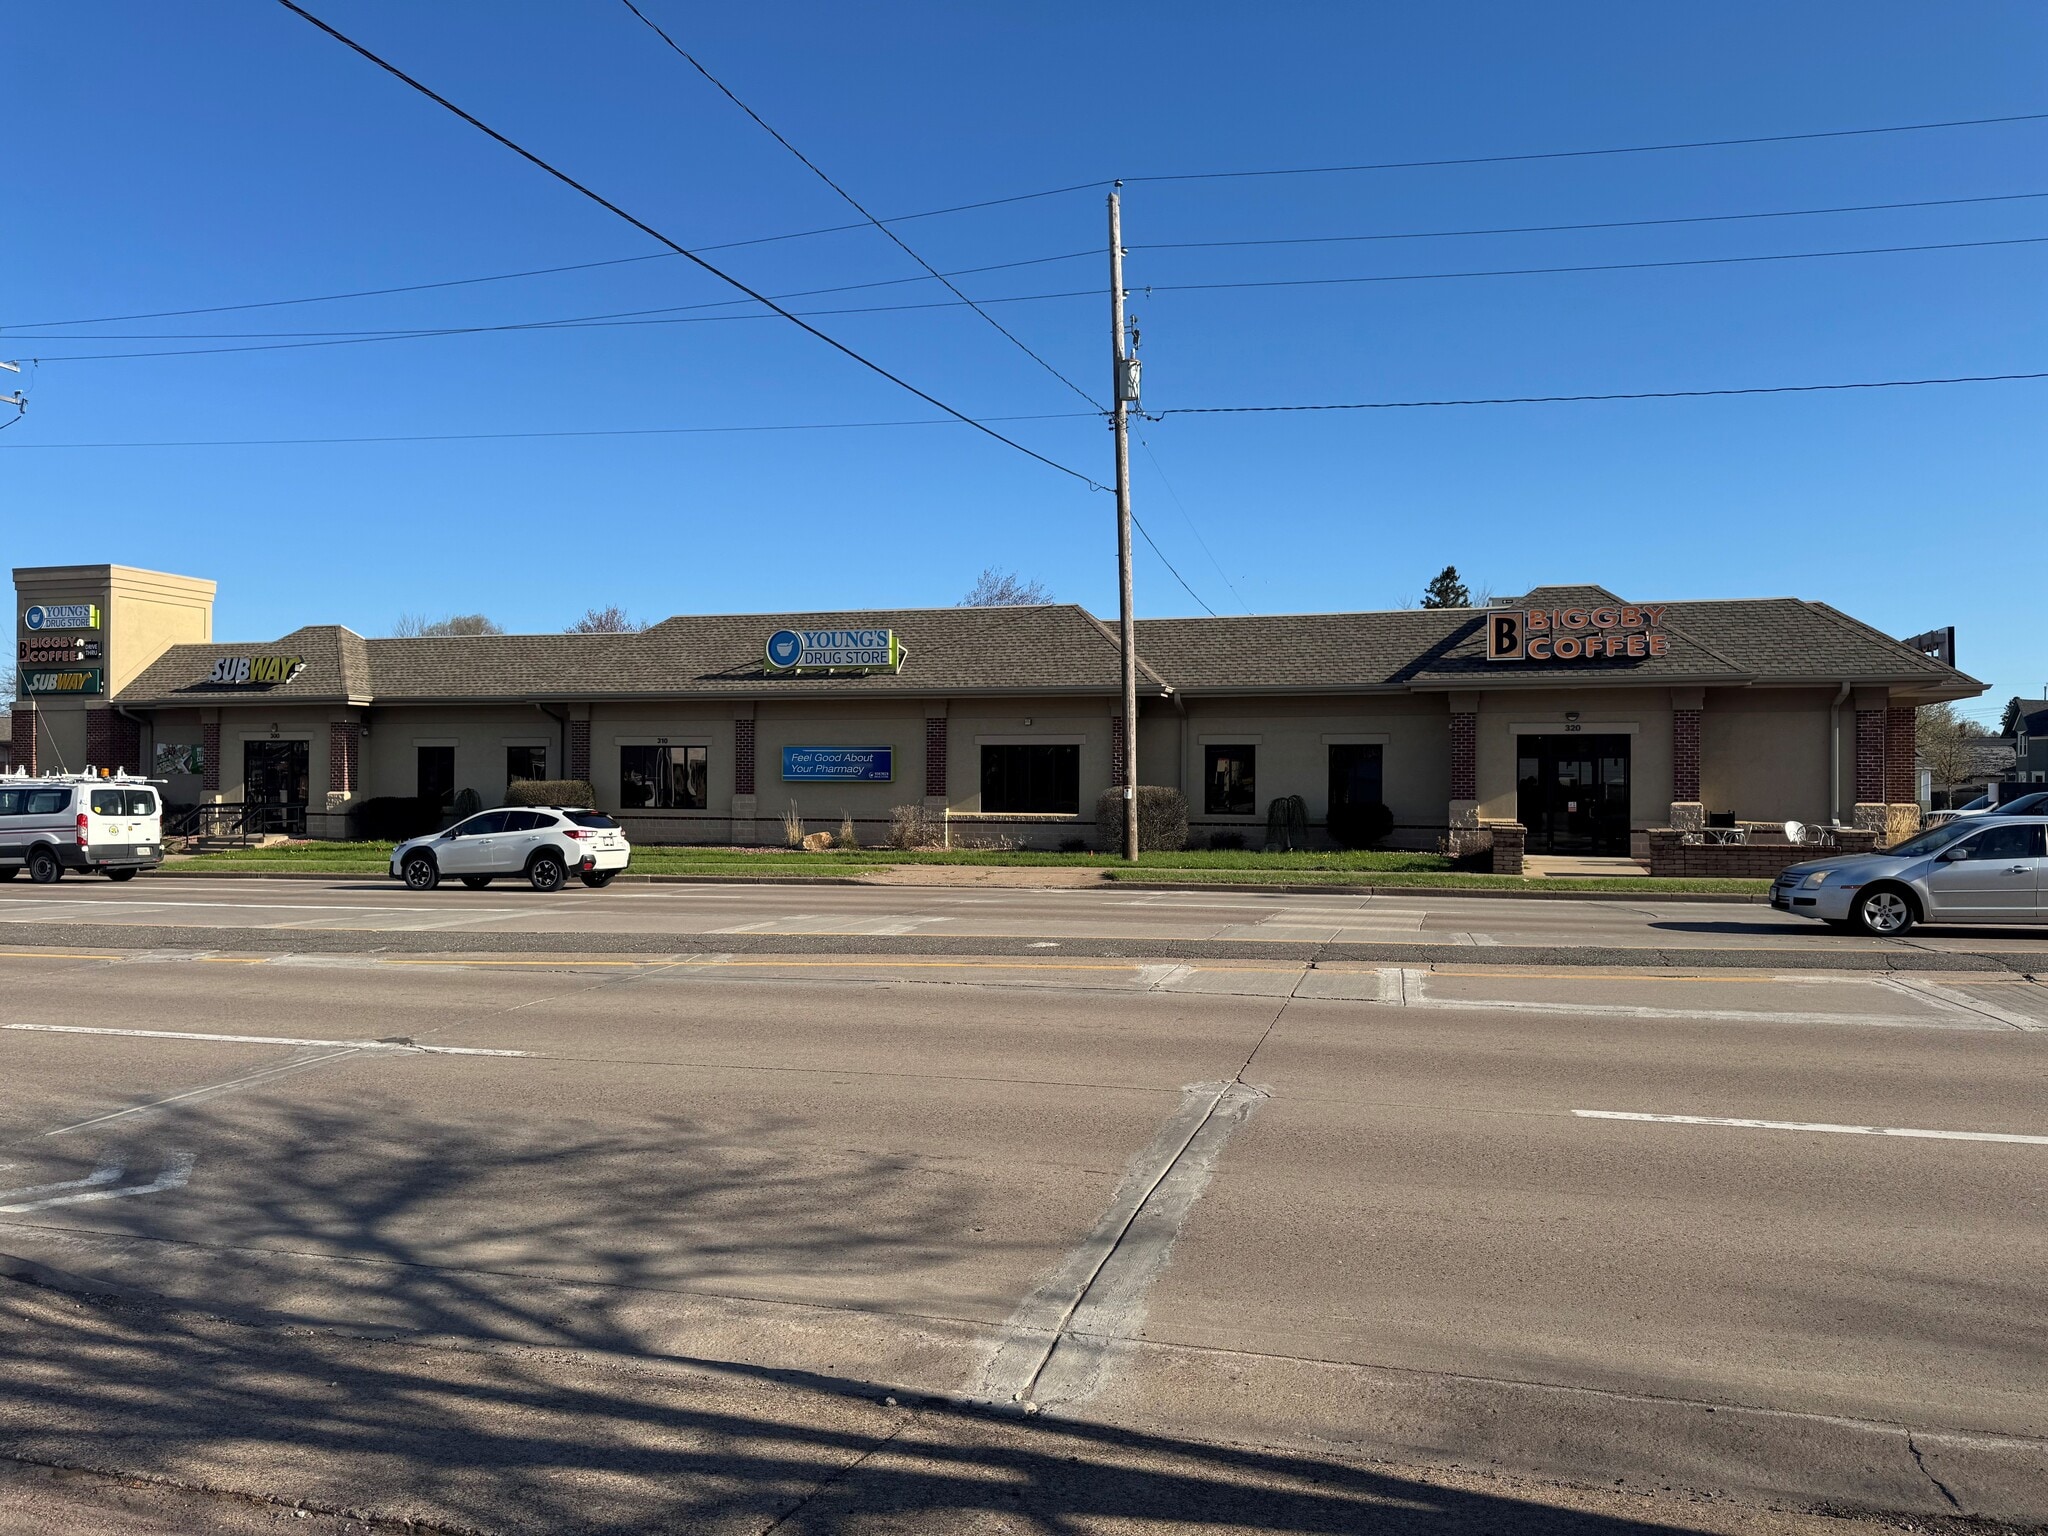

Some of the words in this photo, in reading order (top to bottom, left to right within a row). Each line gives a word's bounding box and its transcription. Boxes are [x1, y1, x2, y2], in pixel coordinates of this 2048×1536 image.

[46, 606, 90, 617] YOUNG'S
[1527, 606, 1667, 630] BIGGBY
[45, 619, 66, 628] DRUG
[67, 618, 90, 627] STORE
[31, 637, 77, 648] BIGGBY
[803, 631, 888, 648] YOUNG'S
[1495, 617, 1518, 655] B
[1527, 634, 1669, 660] COFFEE
[30, 651, 77, 662] COFFEE
[804, 651, 842, 665] DRUG
[845, 650, 888, 664] STORE
[208, 656, 302, 683] SUBWAY
[30, 672, 92, 691] SUBWAY
[1564, 724, 1581, 732] 320
[791, 753, 812, 762] Feel
[814, 753, 842, 763] Good
[843, 753, 874, 763] About
[791, 764, 814, 774] Your
[815, 764, 865, 776] Pharmacy
